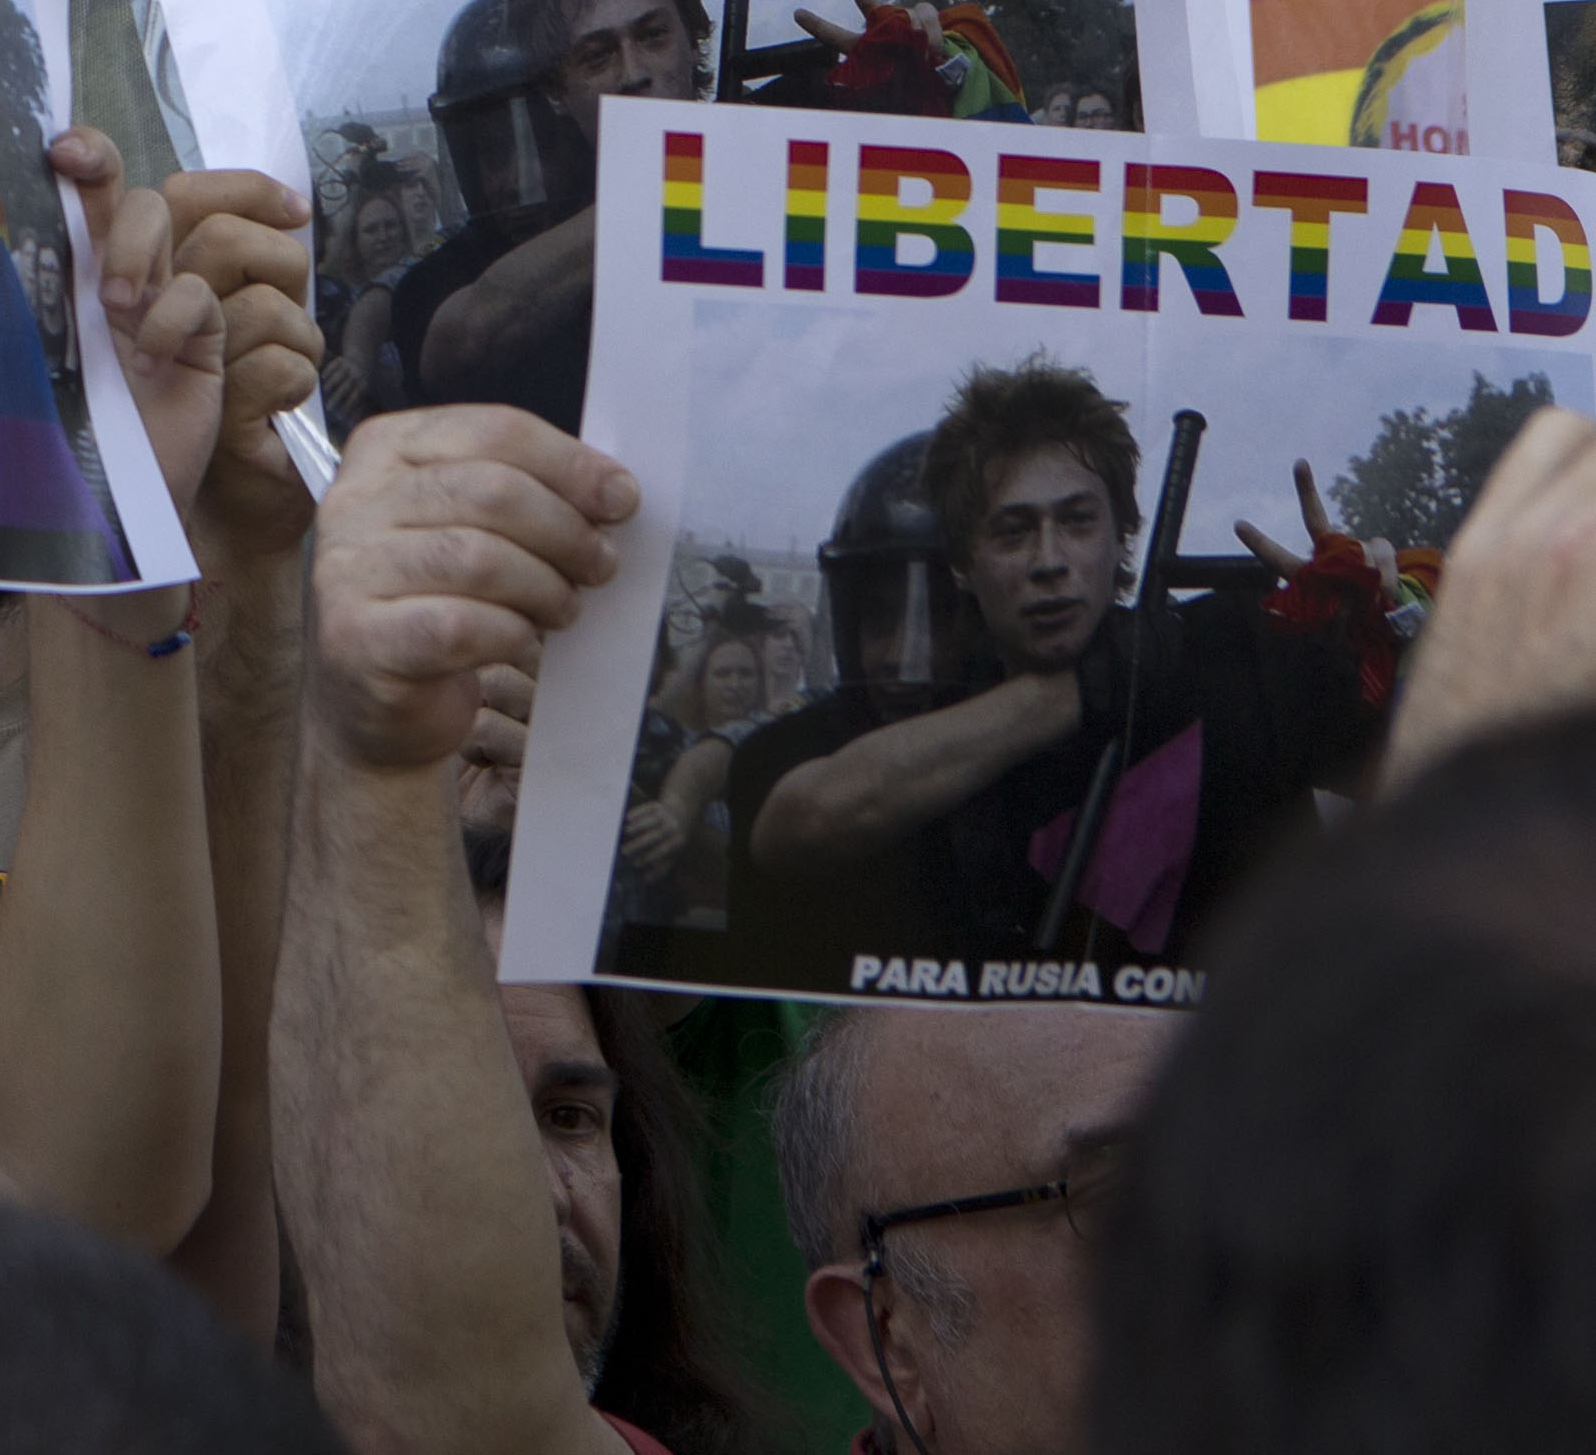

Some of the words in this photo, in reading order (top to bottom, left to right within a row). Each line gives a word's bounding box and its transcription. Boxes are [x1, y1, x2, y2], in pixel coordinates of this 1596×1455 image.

[660, 130, 1593, 337] LIBERTAD
[850, 954, 970, 995] PARA
[978, 961, 1103, 997] RUSIA
